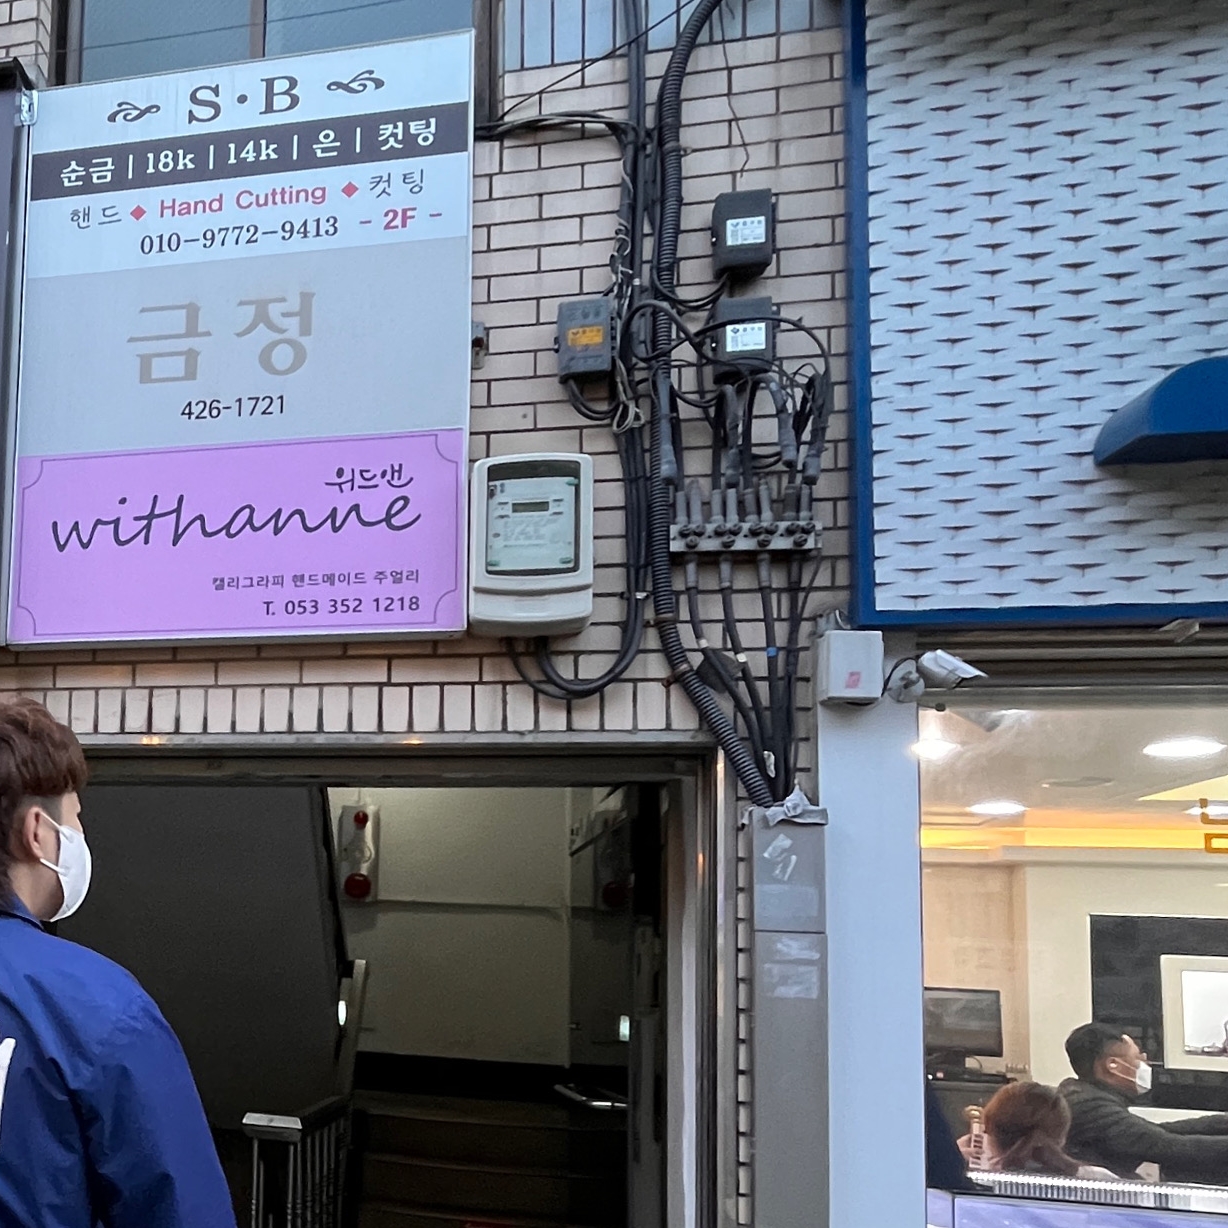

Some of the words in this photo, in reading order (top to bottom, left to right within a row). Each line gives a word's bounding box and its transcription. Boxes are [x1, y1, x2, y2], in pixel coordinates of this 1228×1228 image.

[60, 157, 115, 187] 순금
[146, 149, 196, 174] 18k
[227, 138, 279, 165] 14k
[312, 129, 341, 158] 은
[378, 117, 436, 150] 컷팅
[160, 193, 224, 219] Hand
[235, 185, 327, 210] Cutting
[140, 215, 339, 255] 010-9772-9413
[126, 291, 316, 385] 금정
[180, 394, 285, 420] 426-1721
[324, 463, 414, 494] 위드앤
[51, 494, 422, 553] withanne
[212, 574, 285, 591] 캘리그라피
[374, 569, 420, 585] 주얼리
[263, 601, 276, 616] T.
[284, 599, 319, 616] 053
[328, 597, 363, 614] 352
[372, 596, 421, 612] 1218
